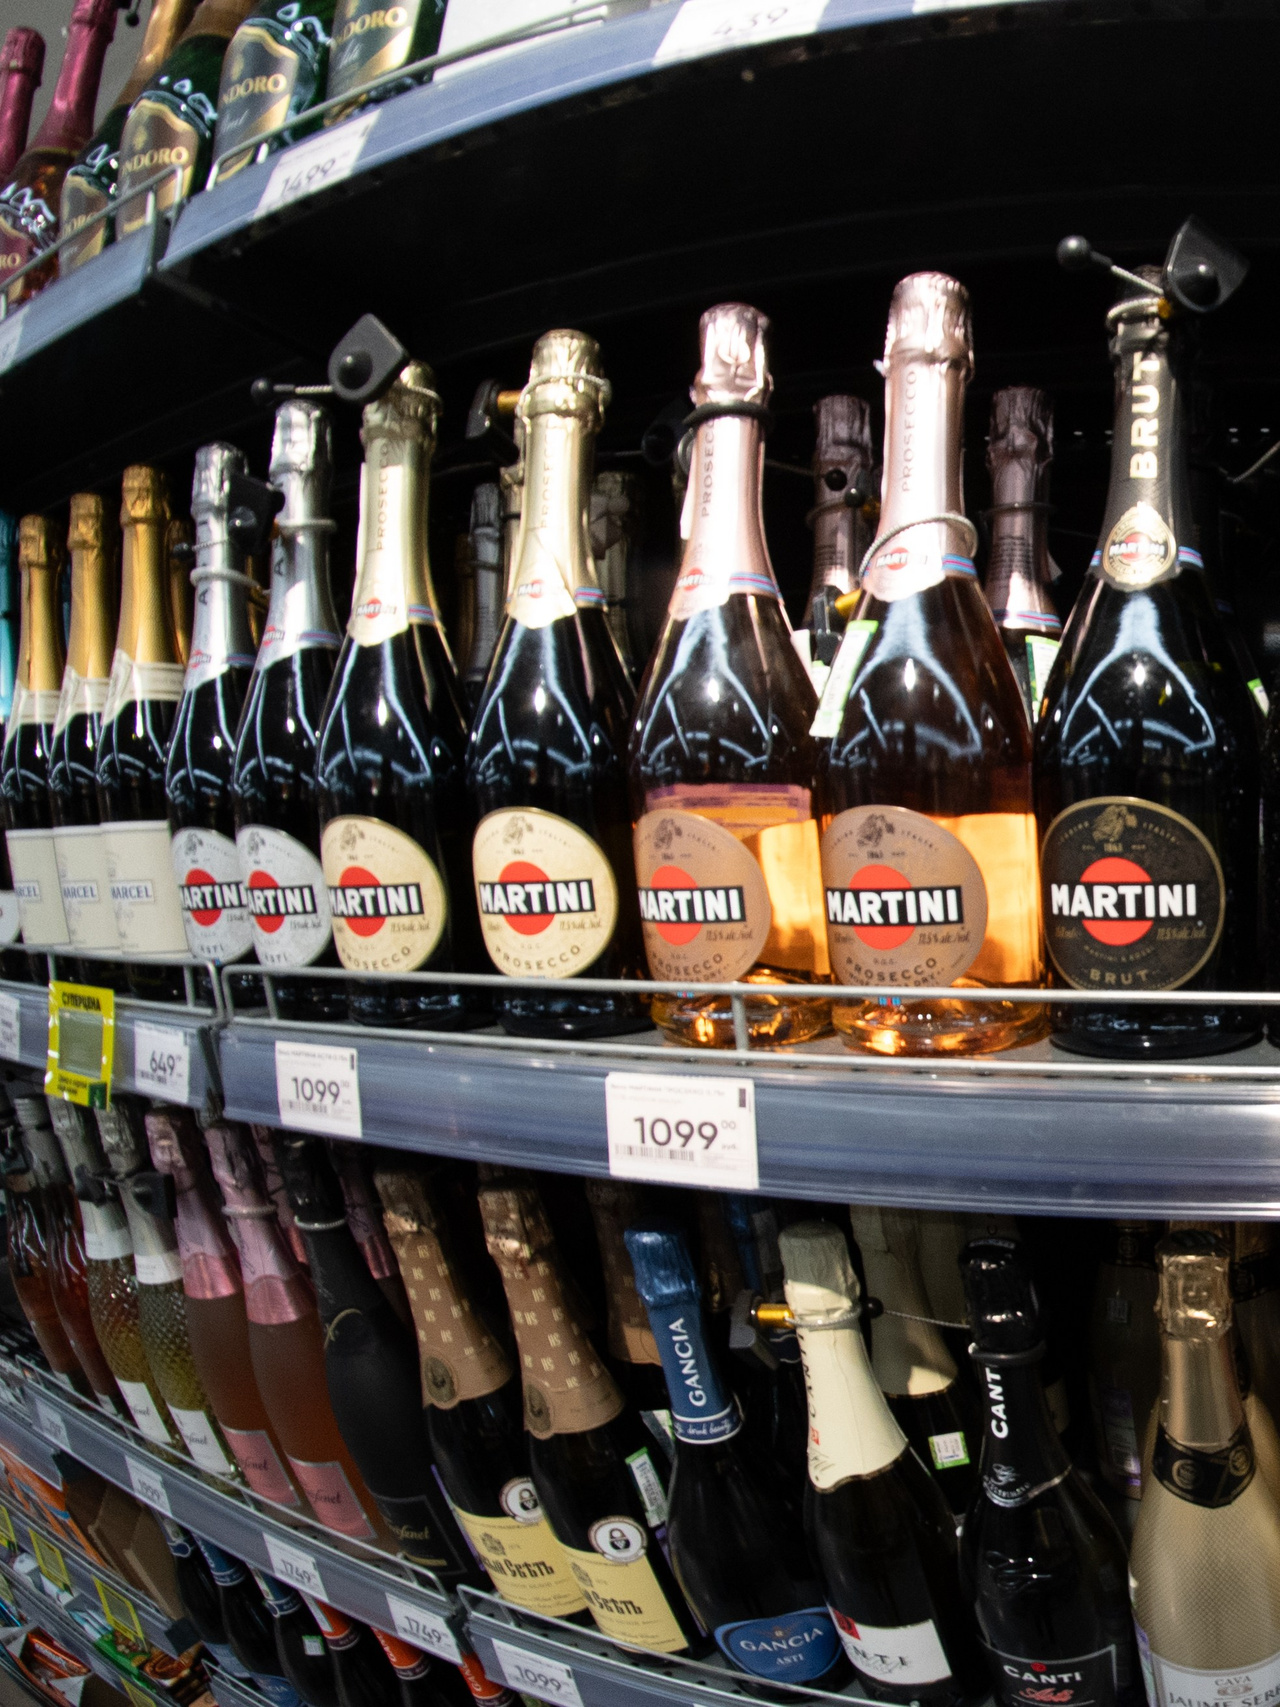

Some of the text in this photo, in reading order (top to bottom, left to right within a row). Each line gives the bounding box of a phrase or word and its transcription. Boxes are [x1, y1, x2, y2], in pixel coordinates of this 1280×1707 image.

[479, 881, 593, 914] MARTINI
[637, 887, 743, 922] MARTINI
[826, 887, 960, 924] MARTINI
[1050, 882, 1197, 918] MARTINI
[1089, 968, 1149, 985] BRUT
[150, 1050, 176, 1077] 649
[291, 1076, 340, 1105] 1099
[633, 1116, 736, 1150] 1099 00
[672, 1318, 707, 1407] GANCIA
[403, 1614, 442, 1644] 1749
[739, 1626, 824, 1652] GANCIA
[514, 1664, 562, 1692] 1099
[1003, 1663, 1082, 1685] CANTI
